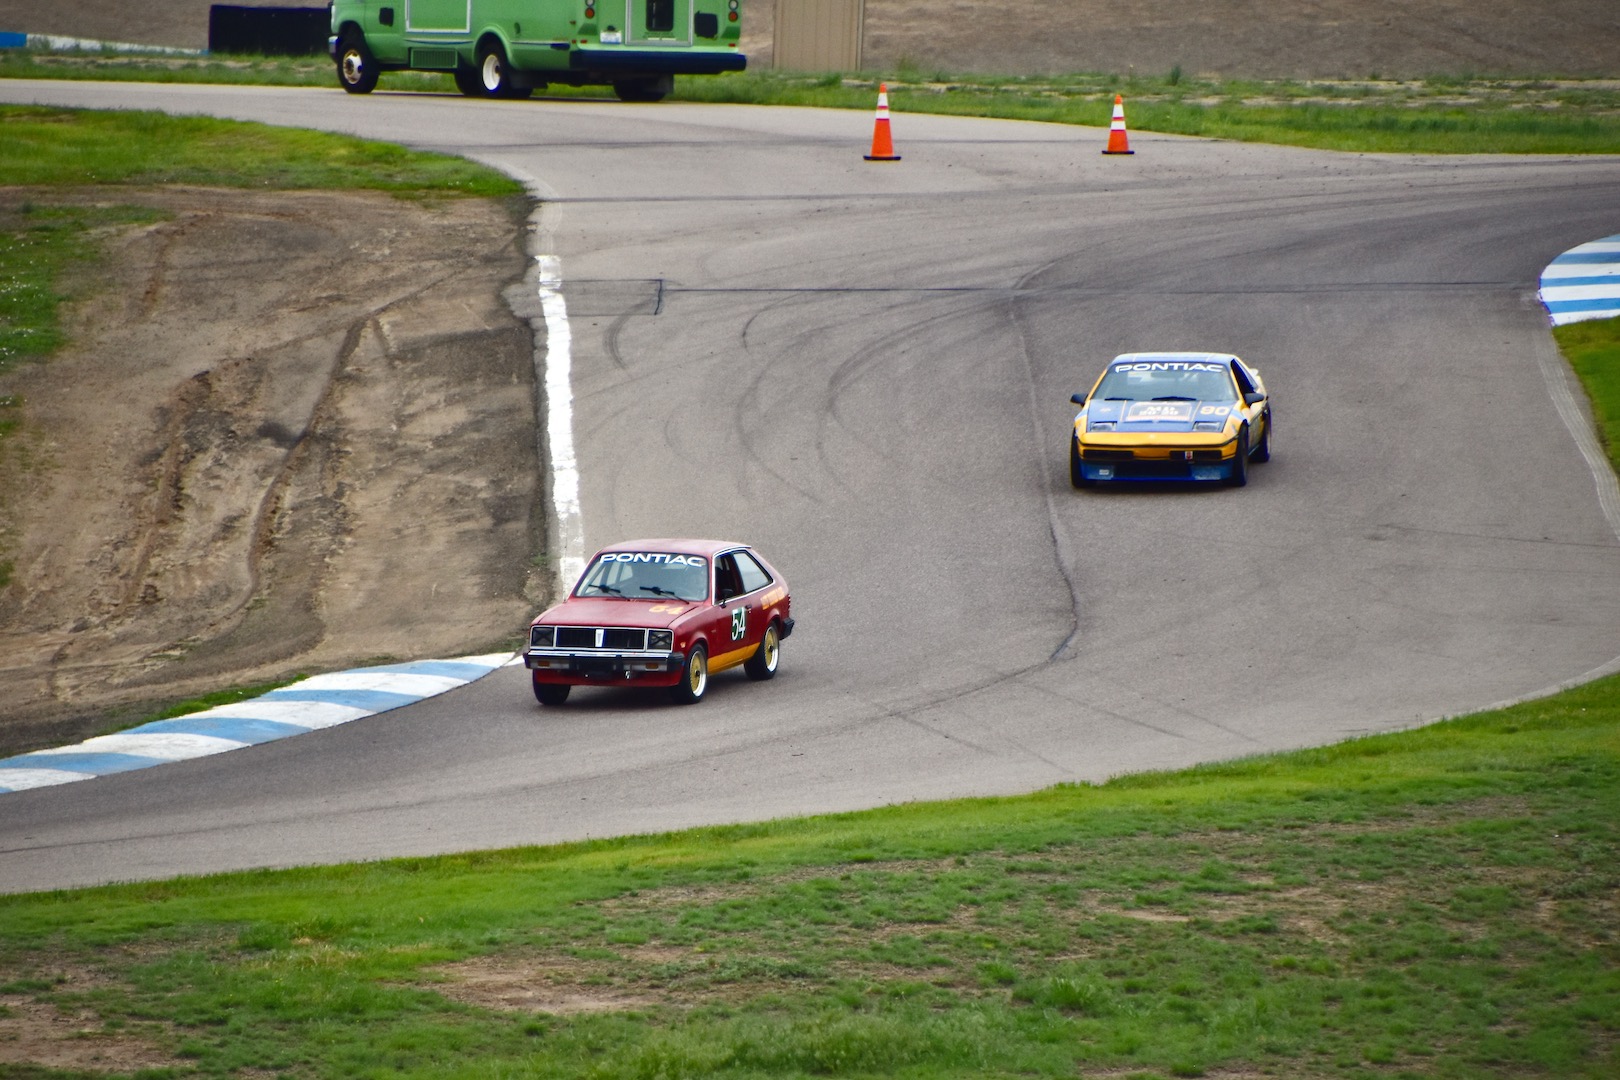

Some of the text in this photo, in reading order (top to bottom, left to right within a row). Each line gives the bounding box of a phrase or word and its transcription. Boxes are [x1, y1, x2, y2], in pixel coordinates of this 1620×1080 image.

[1115, 363, 1223, 373] PONTIAC
[1200, 406, 1229, 416] 90
[600, 554, 705, 567] PONTIAC
[732, 608, 746, 641] 54
